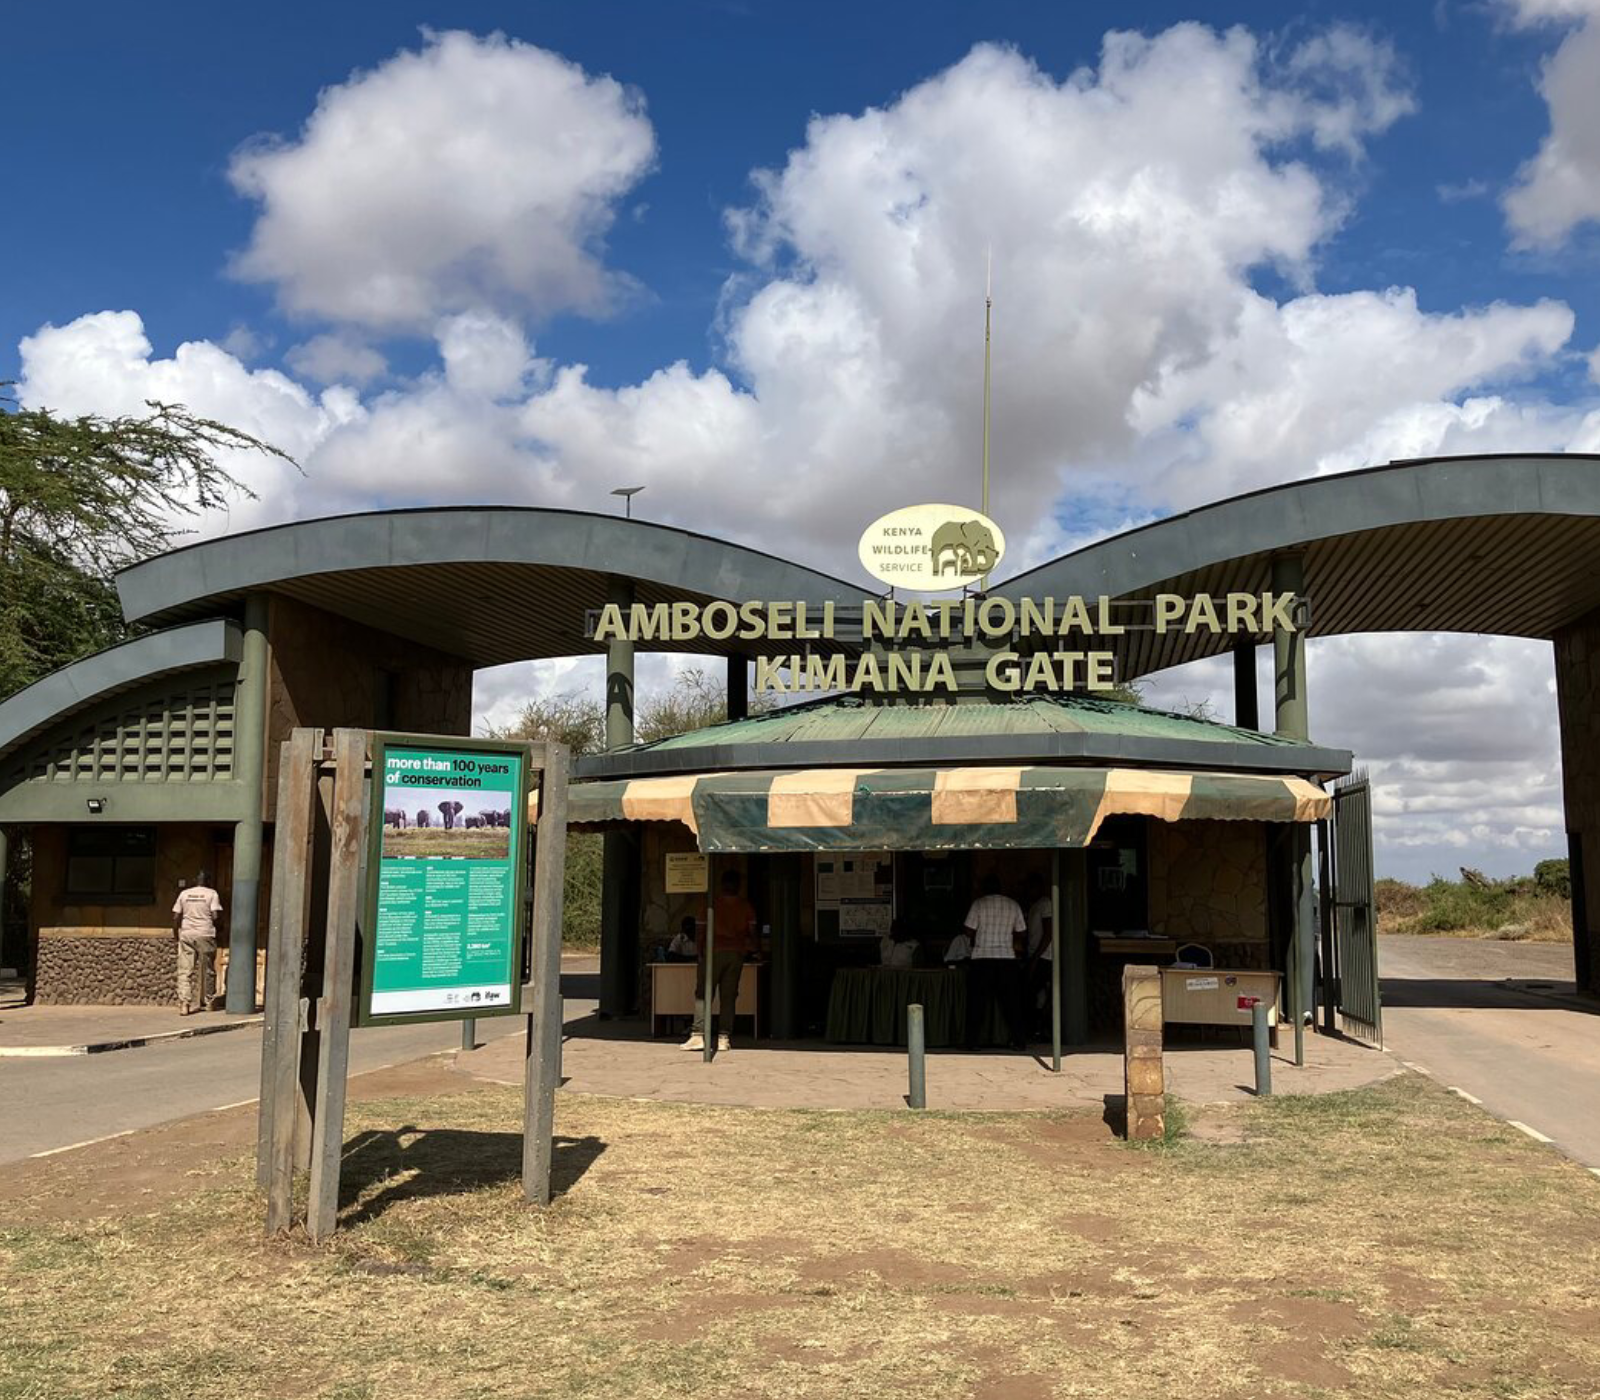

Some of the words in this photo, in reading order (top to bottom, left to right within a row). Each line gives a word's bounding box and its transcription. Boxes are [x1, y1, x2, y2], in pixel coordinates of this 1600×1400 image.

[883, 528, 923, 537] KENYA
[872, 545, 928, 555] WILDLIFE
[880, 563, 923, 572] SERVICE
[594, 601, 835, 641] AMBOSELI
[863, 595, 1125, 638] NATIONAL
[1155, 592, 1297, 634] PARK
[756, 653, 958, 693] KIMANA
[985, 651, 1114, 691] GATE
[387, 758, 421, 769] more
[422, 757, 450, 771] than
[453, 760, 475, 772] 100
[478, 763, 509, 775] years
[386, 771, 400, 783] of
[402, 774, 481, 787] conservation
